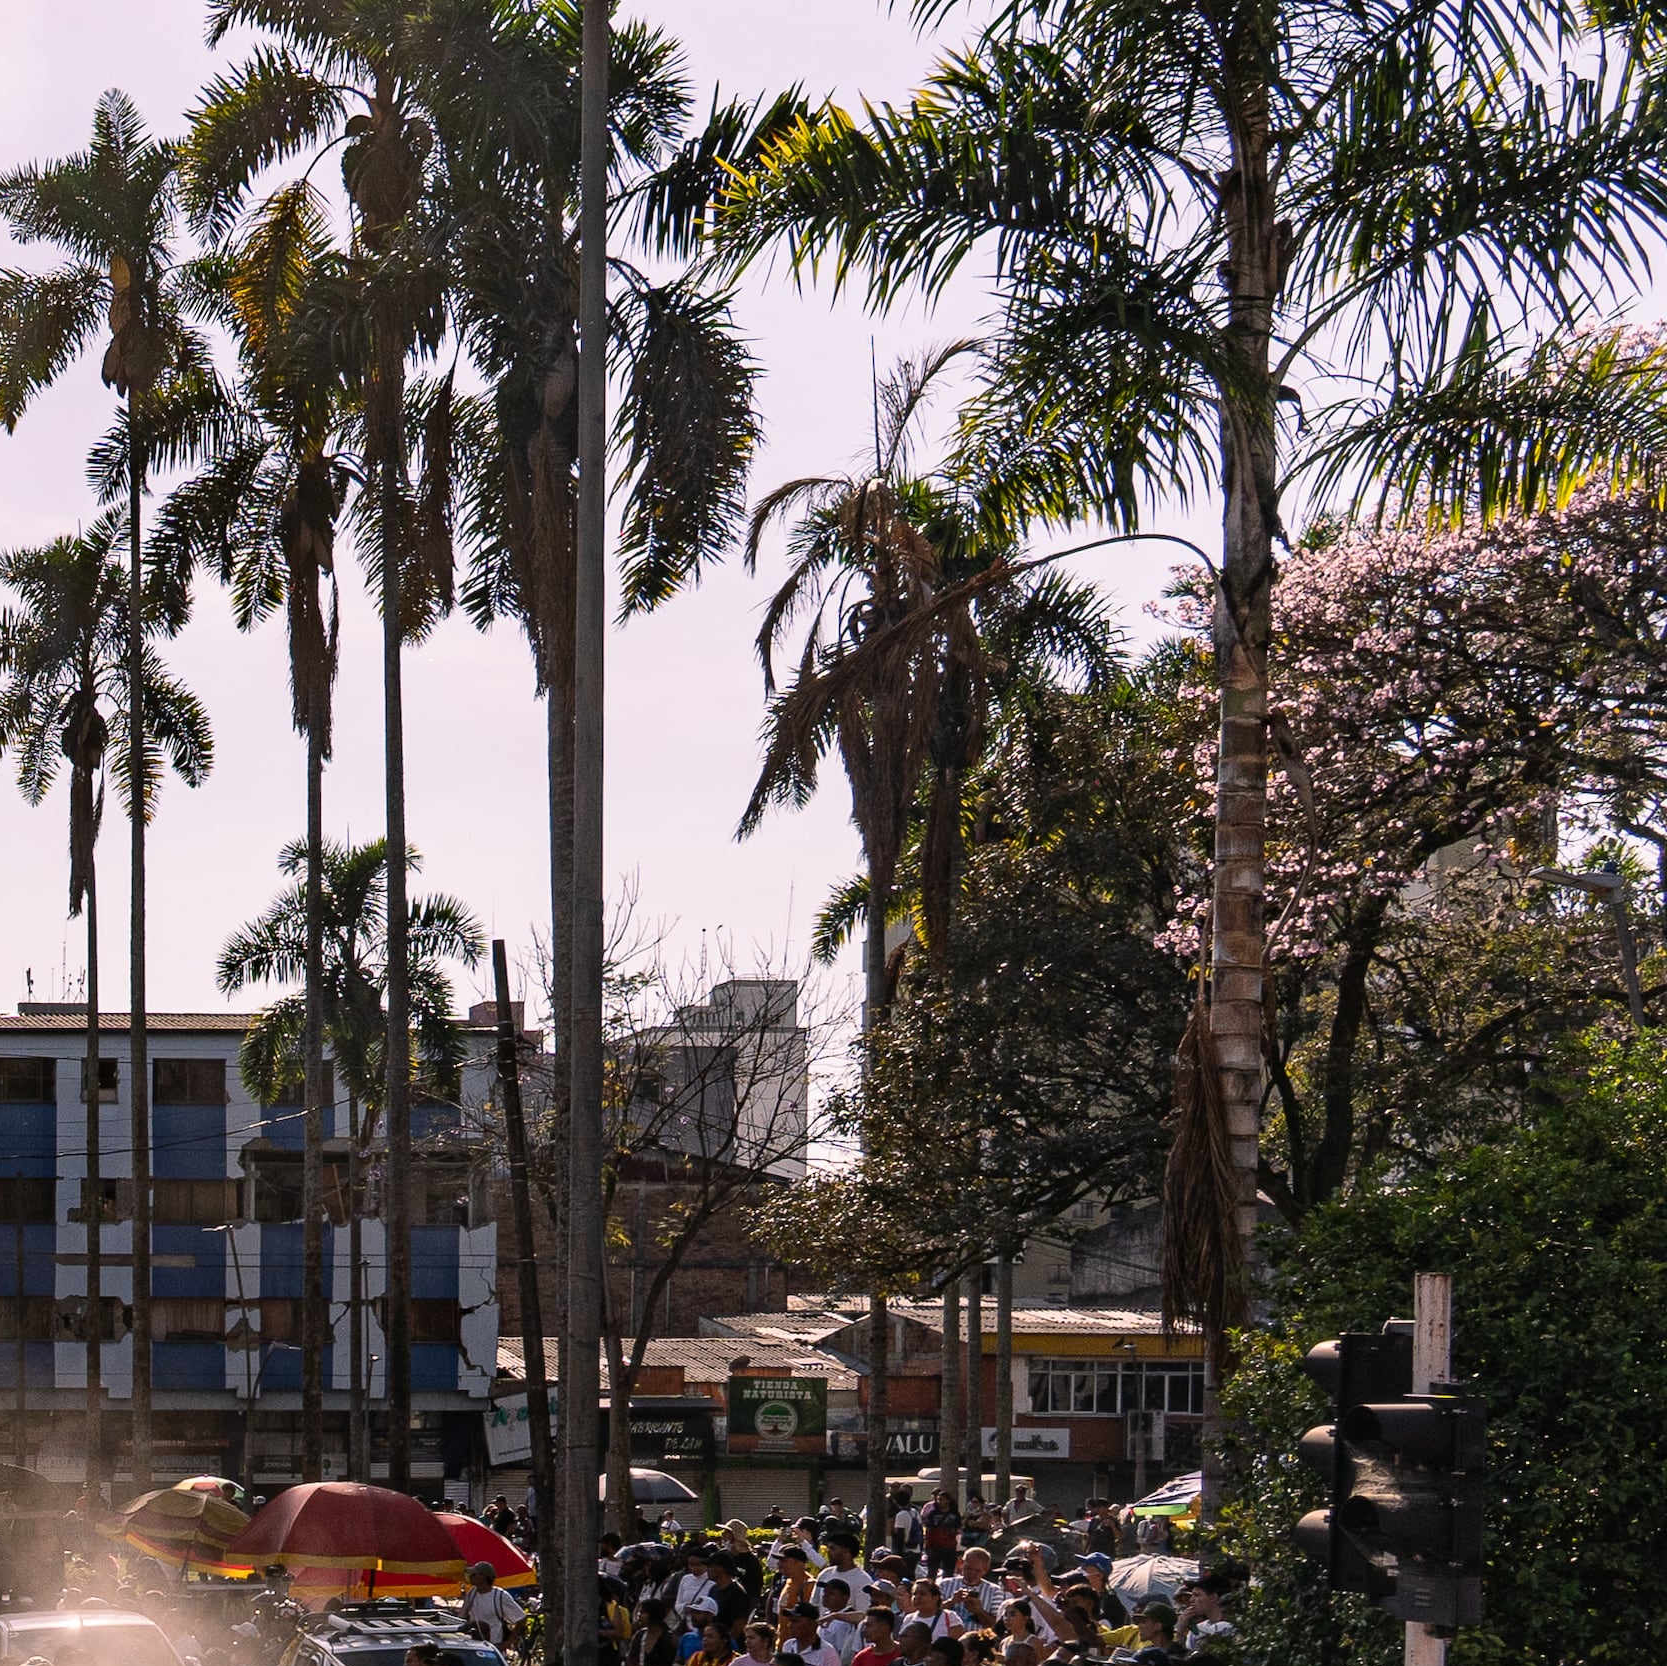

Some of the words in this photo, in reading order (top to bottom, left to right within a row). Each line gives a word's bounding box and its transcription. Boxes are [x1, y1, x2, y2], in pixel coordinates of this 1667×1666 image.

[753, 1380, 799, 1390] TIENDA
[743, 1389, 812, 1400] NATURISTA
[629, 1421, 685, 1435] ABRICANTE
